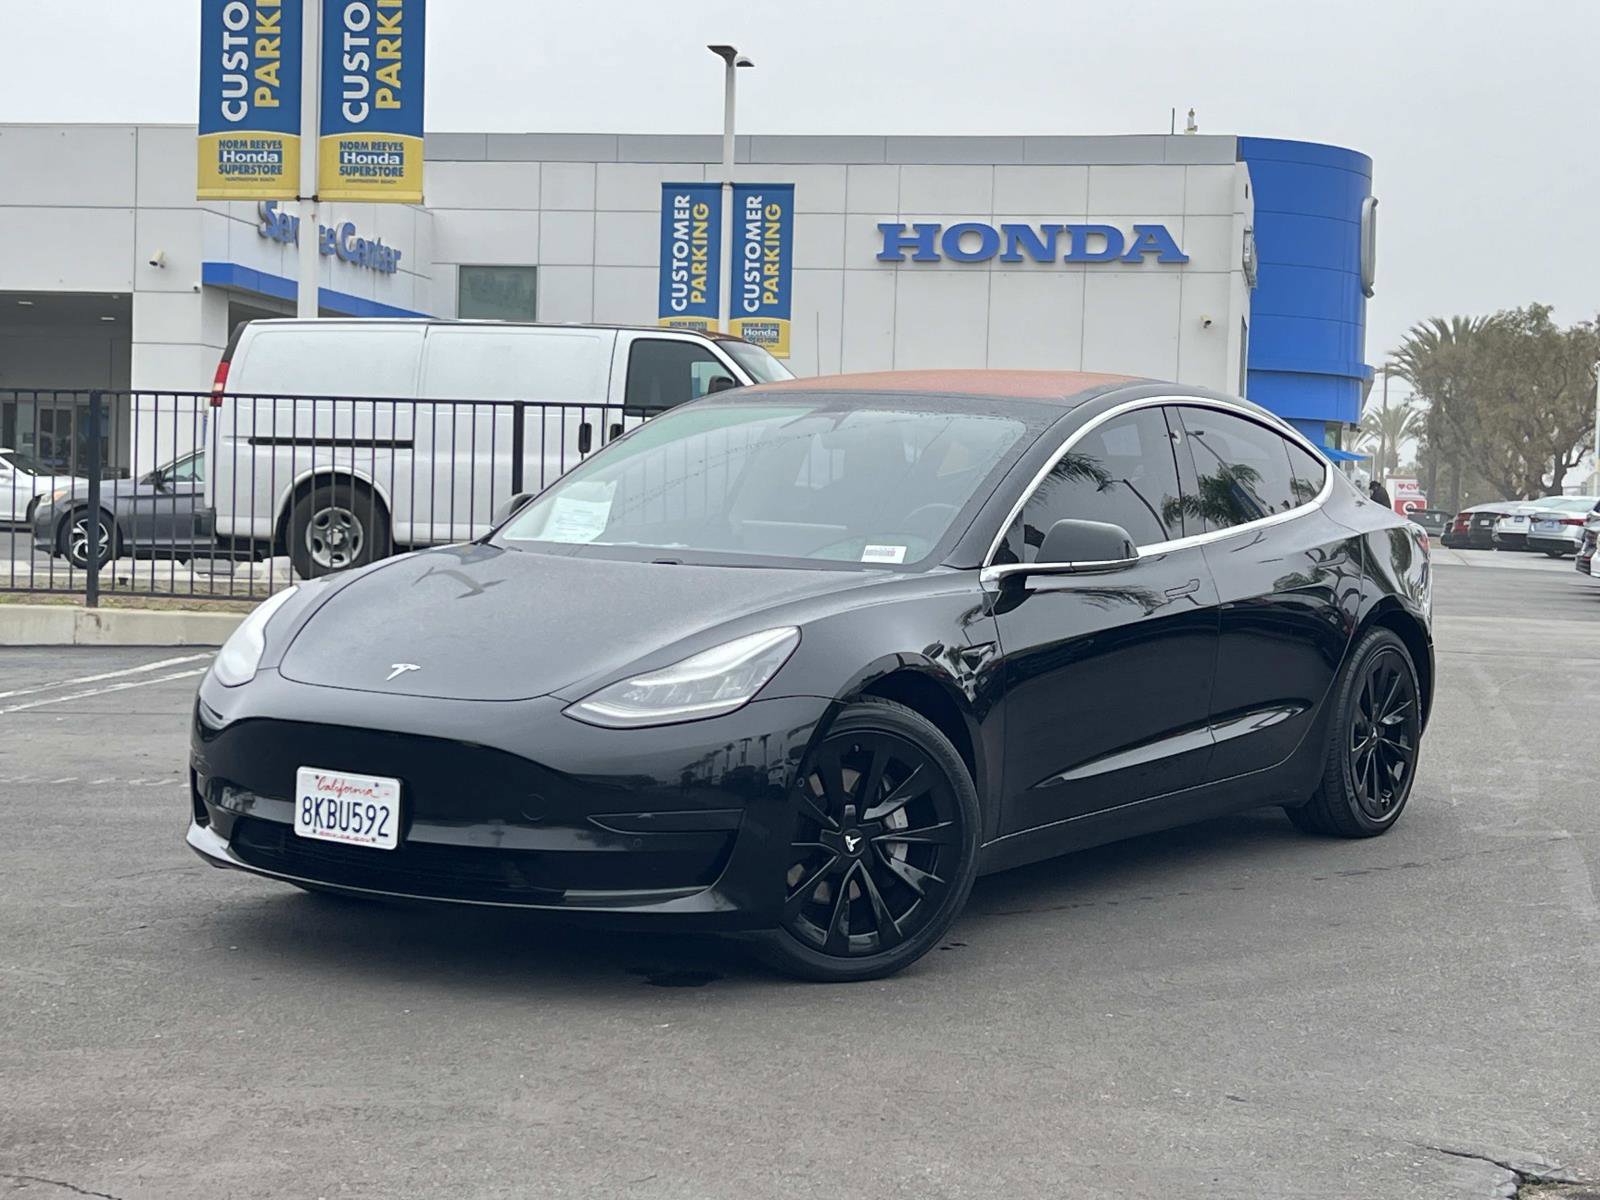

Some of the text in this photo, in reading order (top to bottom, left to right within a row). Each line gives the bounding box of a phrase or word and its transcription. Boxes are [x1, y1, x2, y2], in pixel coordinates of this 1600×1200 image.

[219, 140, 282, 149] NORM REEVES
[340, 141, 404, 151] NORM REEVES
[222, 150, 279, 163] Honda
[343, 151, 400, 165] Honda
[218, 164, 283, 176] SUPERSTORE
[339, 166, 404, 178] SUPERSTORE
[257, 200, 402, 274] Serce Center
[876, 222, 1190, 264] HONDA
[671, 194, 690, 312] CUSTOMER
[690, 203, 709, 303] PARKING
[743, 195, 762, 313] CUSTOMER
[763, 204, 782, 305] PARKING
[743, 328, 778, 336] Honda
[317, 776, 380, 798] California
[302, 796, 390, 838] 8KBU592
